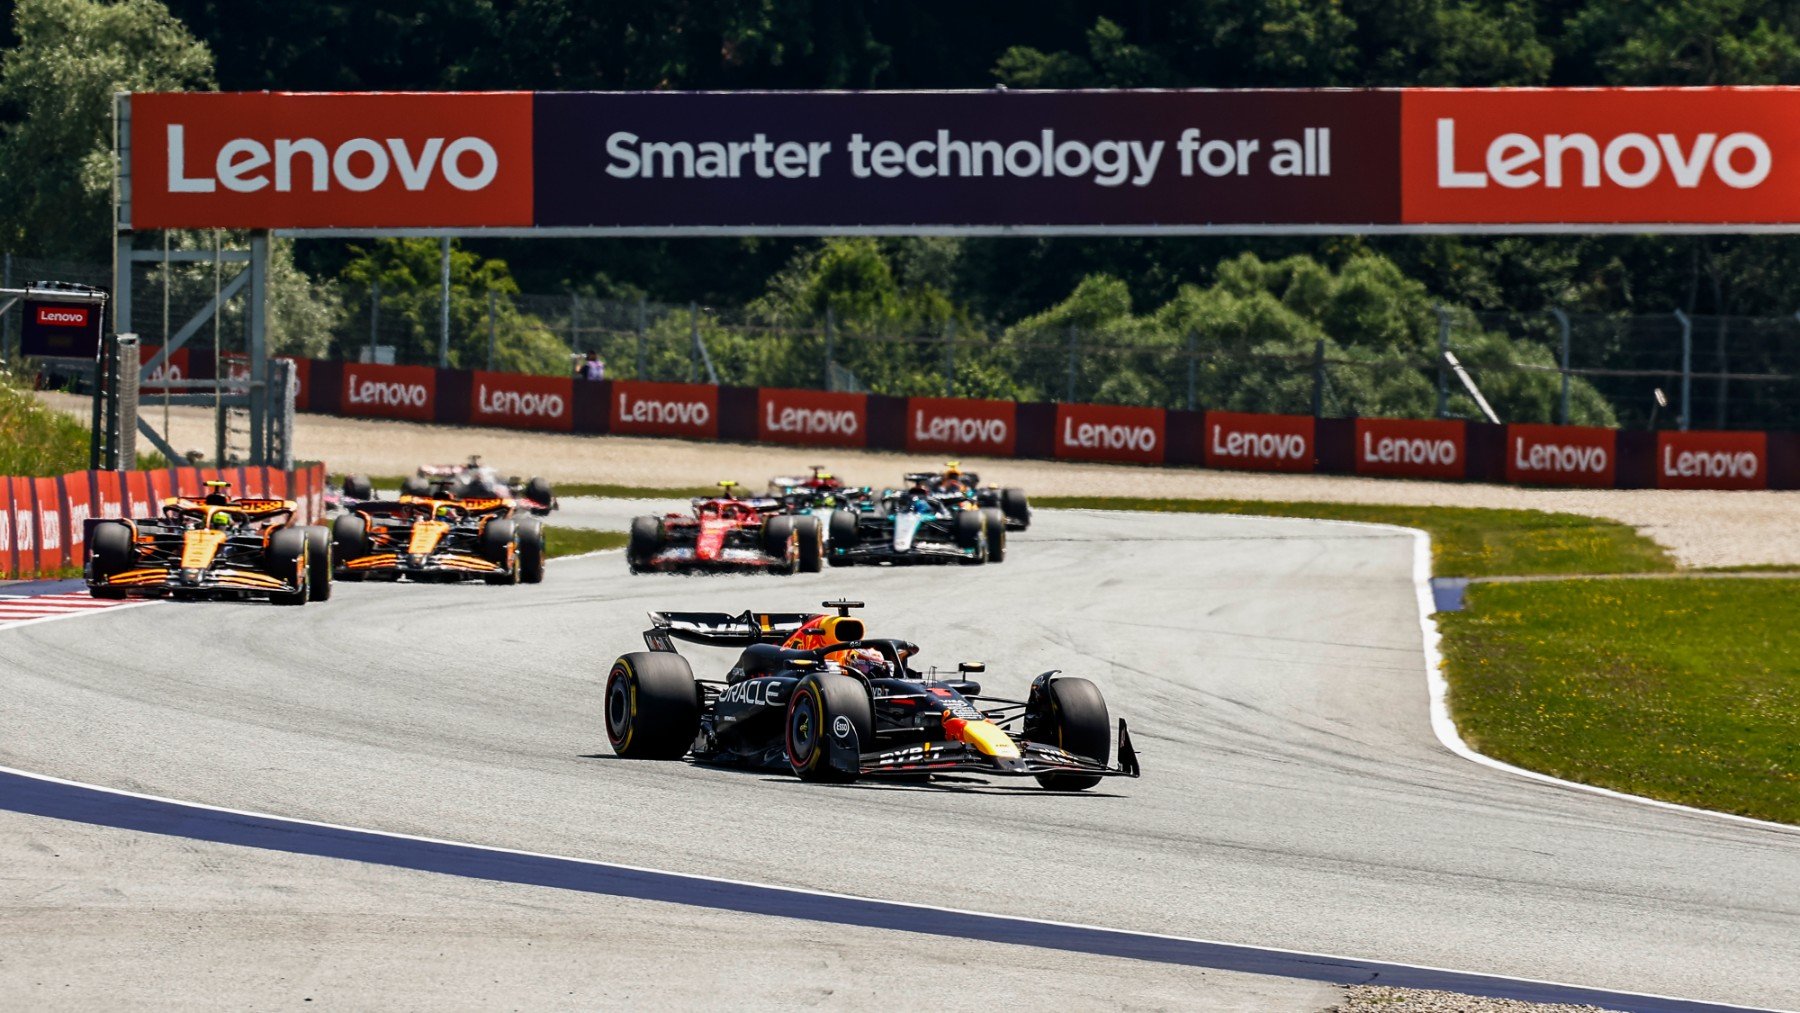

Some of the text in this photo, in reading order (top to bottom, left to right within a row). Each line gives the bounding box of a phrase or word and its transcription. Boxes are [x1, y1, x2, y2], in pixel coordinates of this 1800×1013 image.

[167, 124, 498, 193] Lenovo
[605, 126, 1330, 187] Smarter technology for all
[1437, 117, 1772, 190] Lenovo
[41, 310, 83, 322] Lenovo
[349, 374, 427, 407] Lenovo
[479, 384, 564, 417] Lenovo
[619, 393, 710, 425] Lenovo
[766, 401, 858, 435] Lenovo
[915, 410, 1007, 443] Lenovo
[1064, 417, 1156, 451] Lenovo
[1213, 424, 1306, 459] Lenovo
[1364, 431, 1456, 465] Lenovo
[1516, 437, 1607, 473] Lenovo
[1664, 444, 1758, 477] Lenovo
[718, 681, 786, 707] ORACLE
[836, 721, 848, 731] Esso
